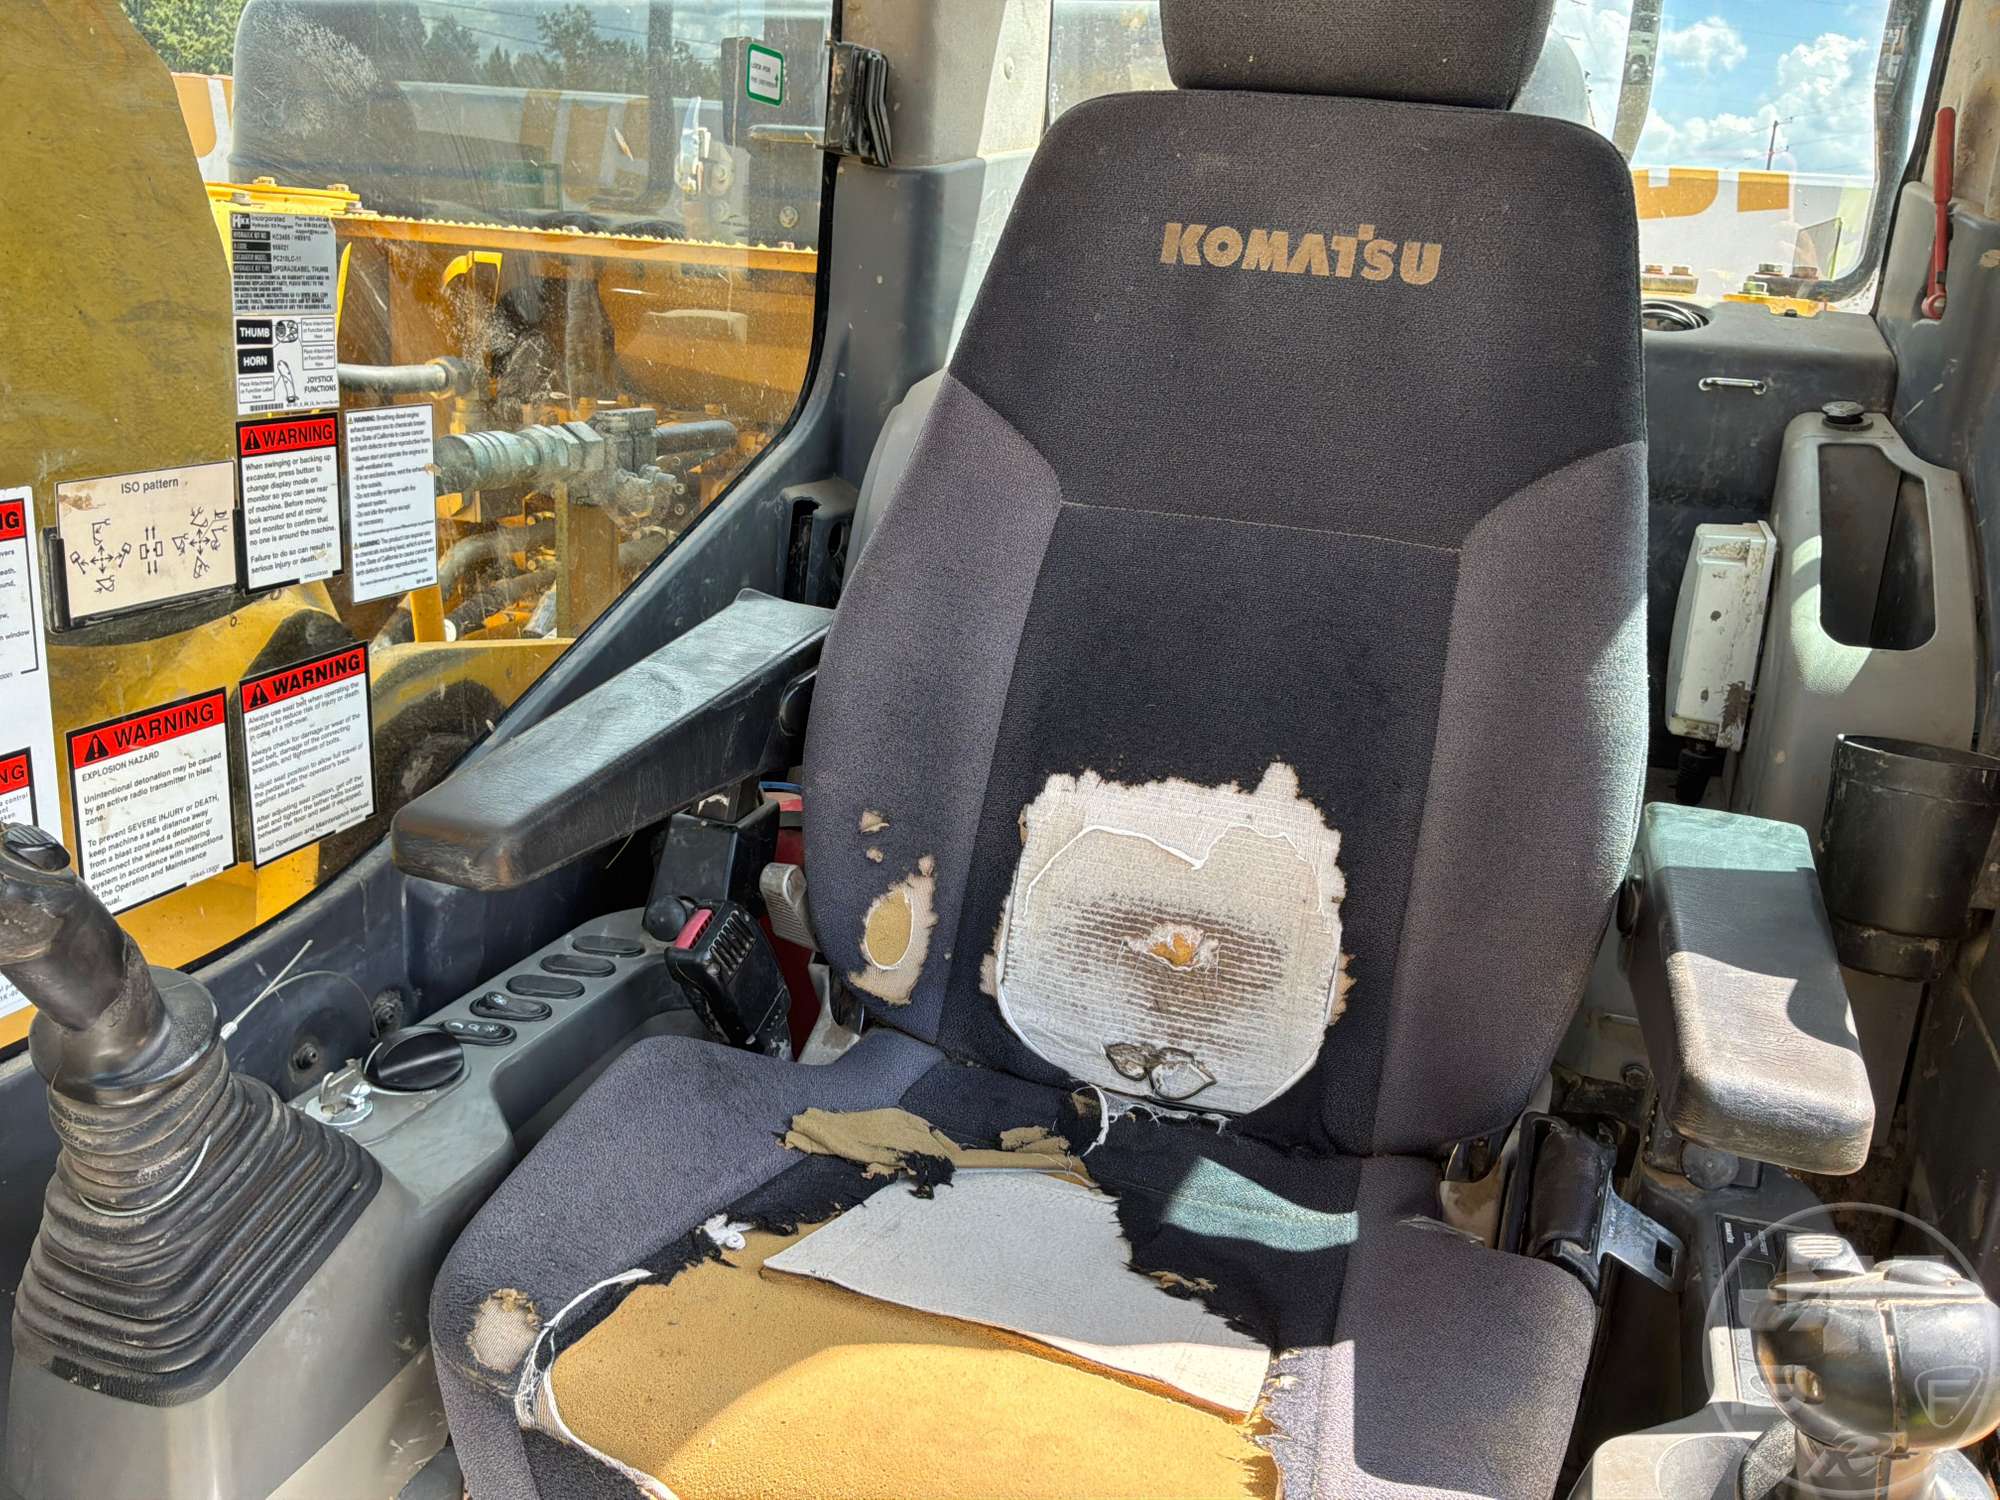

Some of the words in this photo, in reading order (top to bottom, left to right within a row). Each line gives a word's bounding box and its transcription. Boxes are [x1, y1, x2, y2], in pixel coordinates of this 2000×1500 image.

[1159, 222, 1442, 285] KOMATSU
[240, 328, 270, 337] THUMB
[243, 356, 267, 366] HORN
[307, 376, 334, 384] JOYSTICK
[304, 385, 336, 393] FUNCTIONS
[262, 423, 332, 447] WARNING
[264, 459, 290, 468] swinging
[246, 472, 276, 481] excavator,
[278, 470, 294, 478] press
[121, 482, 140, 494] ISO
[143, 478, 179, 492] pattern
[270, 481, 291, 489] display
[247, 494, 270, 503] monitor
[255, 503, 282, 512] machine.
[262, 524, 284, 532] monitor
[294, 518, 315, 527] confirm
[263, 512, 284, 522] around
[278, 531, 298, 540] around
[310, 525, 335, 534] machine.
[250, 554, 270, 562] Failure
[310, 542, 324, 551] result
[251, 564, 272, 573] serious
[274, 560, 290, 569] injury
[300, 554, 316, 563] death.
[5, 630, 30, 640] window
[273, 653, 359, 696] WARNING
[114, 702, 213, 749] WARNING
[82, 761, 126, 781] EXPLOSION
[128, 750, 158, 766] HAZARD
[84, 781, 131, 804] Unintentional
[133, 770, 170, 787] detonation
[172, 764, 186, 773] may
[198, 751, 221, 764] caused
[84, 807, 93, 815] by
[106, 795, 127, 807] active
[130, 788, 147, 799] radio
[149, 775, 186, 792] transmitter
[196, 764, 211, 776] blast
[5, 792, 28, 804] control
[86, 815, 105, 826] zone.
[88, 840, 96, 848] To
[98, 827, 125, 846] prevent
[127, 816, 156, 833] SEVERE
[158, 806, 183, 821] INJURY
[194, 793, 219, 808] DEATH,
[88, 848, 106, 858] keep
[108, 835, 137, 851] machine
[146, 826, 159, 837] safe
[161, 816, 189, 830] distance
[192, 809, 208, 819] away
[90, 859, 106, 869] from
[114, 846, 131, 859] blast
[134, 841, 150, 852] zone
[152, 834, 164, 845] and
[172, 820, 203, 837] detonator
[90, 858, 130, 880] disconnect
[132, 855, 142, 864] the
[144, 843, 172, 858] wireless
[174, 829, 209, 846] monitoring
[92, 876, 117, 891] system
[128, 856, 167, 876] accordance
[169, 848, 182, 859] with
[184, 834, 222, 853] instructions
[101, 889, 112, 898] the
[114, 874, 149, 892] Operation
[151, 866, 163, 877] and
[165, 851, 206, 871] Maintenance
